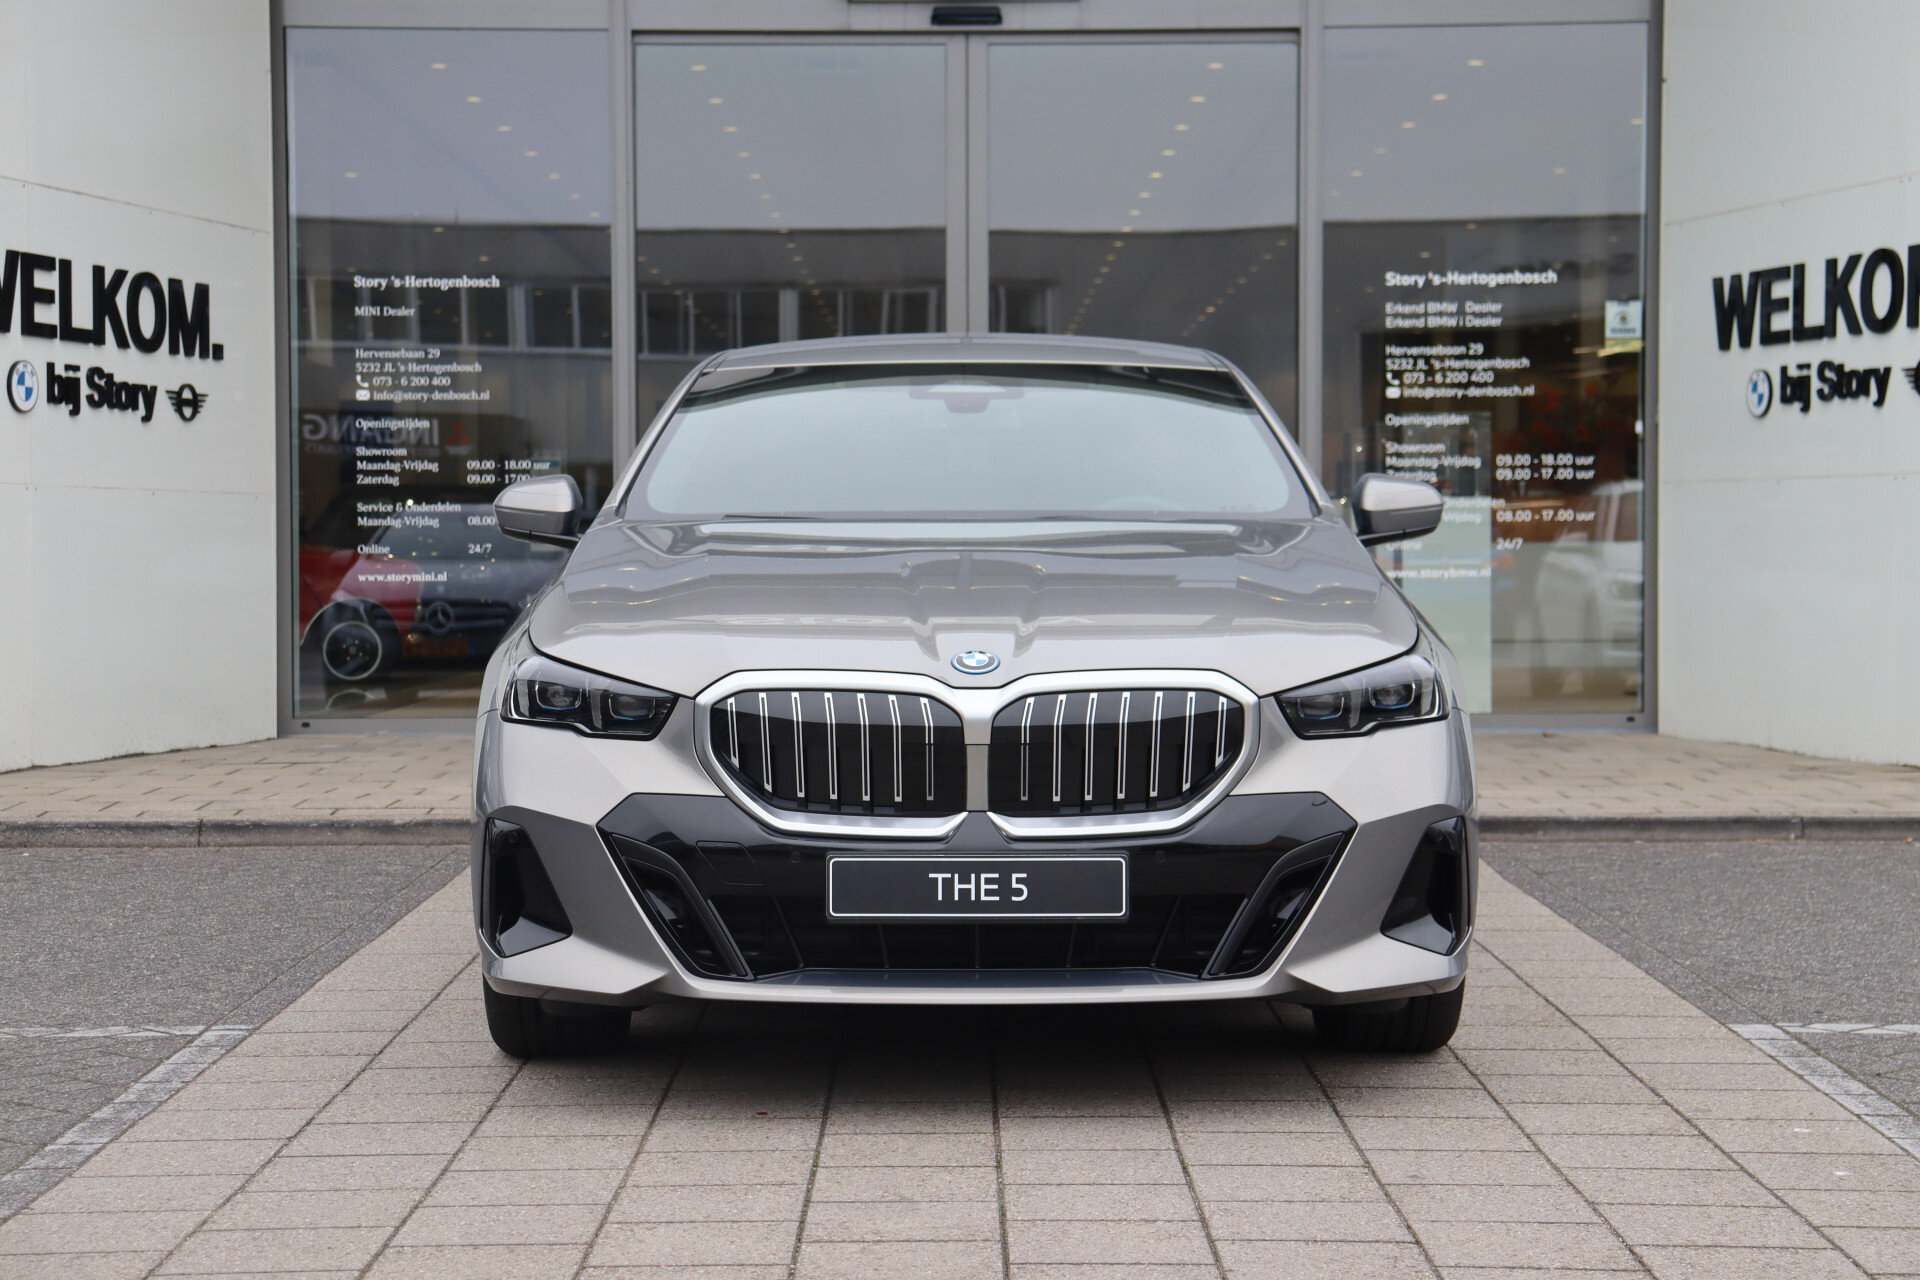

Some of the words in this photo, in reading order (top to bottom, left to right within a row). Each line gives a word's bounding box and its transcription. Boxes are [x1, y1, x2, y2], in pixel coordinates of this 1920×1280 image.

[353, 275, 388, 291] Story
[391, 275, 500, 291] 's-Hertogenbosch
[1384, 271, 1426, 288] Story
[1428, 269, 1558, 288] 's-Hertogenbosch
[354, 306, 381, 317] MINI
[383, 306, 416, 317] Dealer
[1384, 302, 1426, 315] Erkend
[1427, 302, 1458, 315] BMW
[1464, 301, 1503, 313] Dealer
[1384, 316, 1426, 329] Erkend
[1427, 316, 1457, 328] BMW
[1465, 315, 1503, 328] Dealer
[355, 348, 425, 359] Hervensebaan
[427, 348, 441, 359] 29
[1384, 344, 1467, 357] Hervensebaan
[1468, 343, 1484, 356] 29
[355, 363, 381, 373] 5232
[1385, 358, 1415, 371] 5232
[1416, 358, 1429, 371] JL
[373, 376, 392, 387] 073
[400, 376, 408, 387] 6
[410, 376, 429, 387] 200
[431, 376, 451, 387] 400
[1403, 372, 1425, 385] 073
[1434, 372, 1443, 384] 6
[1445, 371, 1468, 384] 200
[1470, 371, 1495, 384] 400
[47, 362, 81, 417] bij
[85, 366, 158, 423] Story
[1780, 363, 1812, 414] bij
[1816, 360, 1892, 409] Story
[355, 418, 431, 431] Openingstijden
[1384, 414, 1470, 428] Openingstijden
[355, 447, 408, 457] Showroom
[1384, 442, 1446, 454] Showroom
[356, 460, 440, 473] Maandag-Vrijdag
[466, 460, 495, 471] 09.00
[504, 460, 532, 471] 18.00
[533, 462, 551, 470] uur
[1384, 454, 1482, 469] Maandag-Vrijdag
[1496, 453, 1531, 467] 09.00
[1541, 453, 1573, 466] 18.00
[1575, 455, 1595, 466] uur
[356, 474, 400, 487] Zaterdag
[466, 474, 495, 485] 09.00
[1496, 468, 1531, 481] 09.00
[1575, 469, 1595, 480] uur
[356, 502, 394, 513] Service
[396, 502, 403, 513] &
[405, 502, 462, 513] Onderdelen
[357, 516, 440, 529] Maandag-Vrijdag
[467, 516, 496, 526] 08.00
[1496, 510, 1532, 523] 08.00
[1576, 510, 1596, 522] uur
[357, 544, 391, 555] Online
[468, 544, 493, 555] 24/7
[1496, 538, 1524, 551] 24/7
[358, 571, 448, 584] www.storymini.nl
[928, 873, 1000, 901] THE
[1011, 873, 1029, 901] 5
